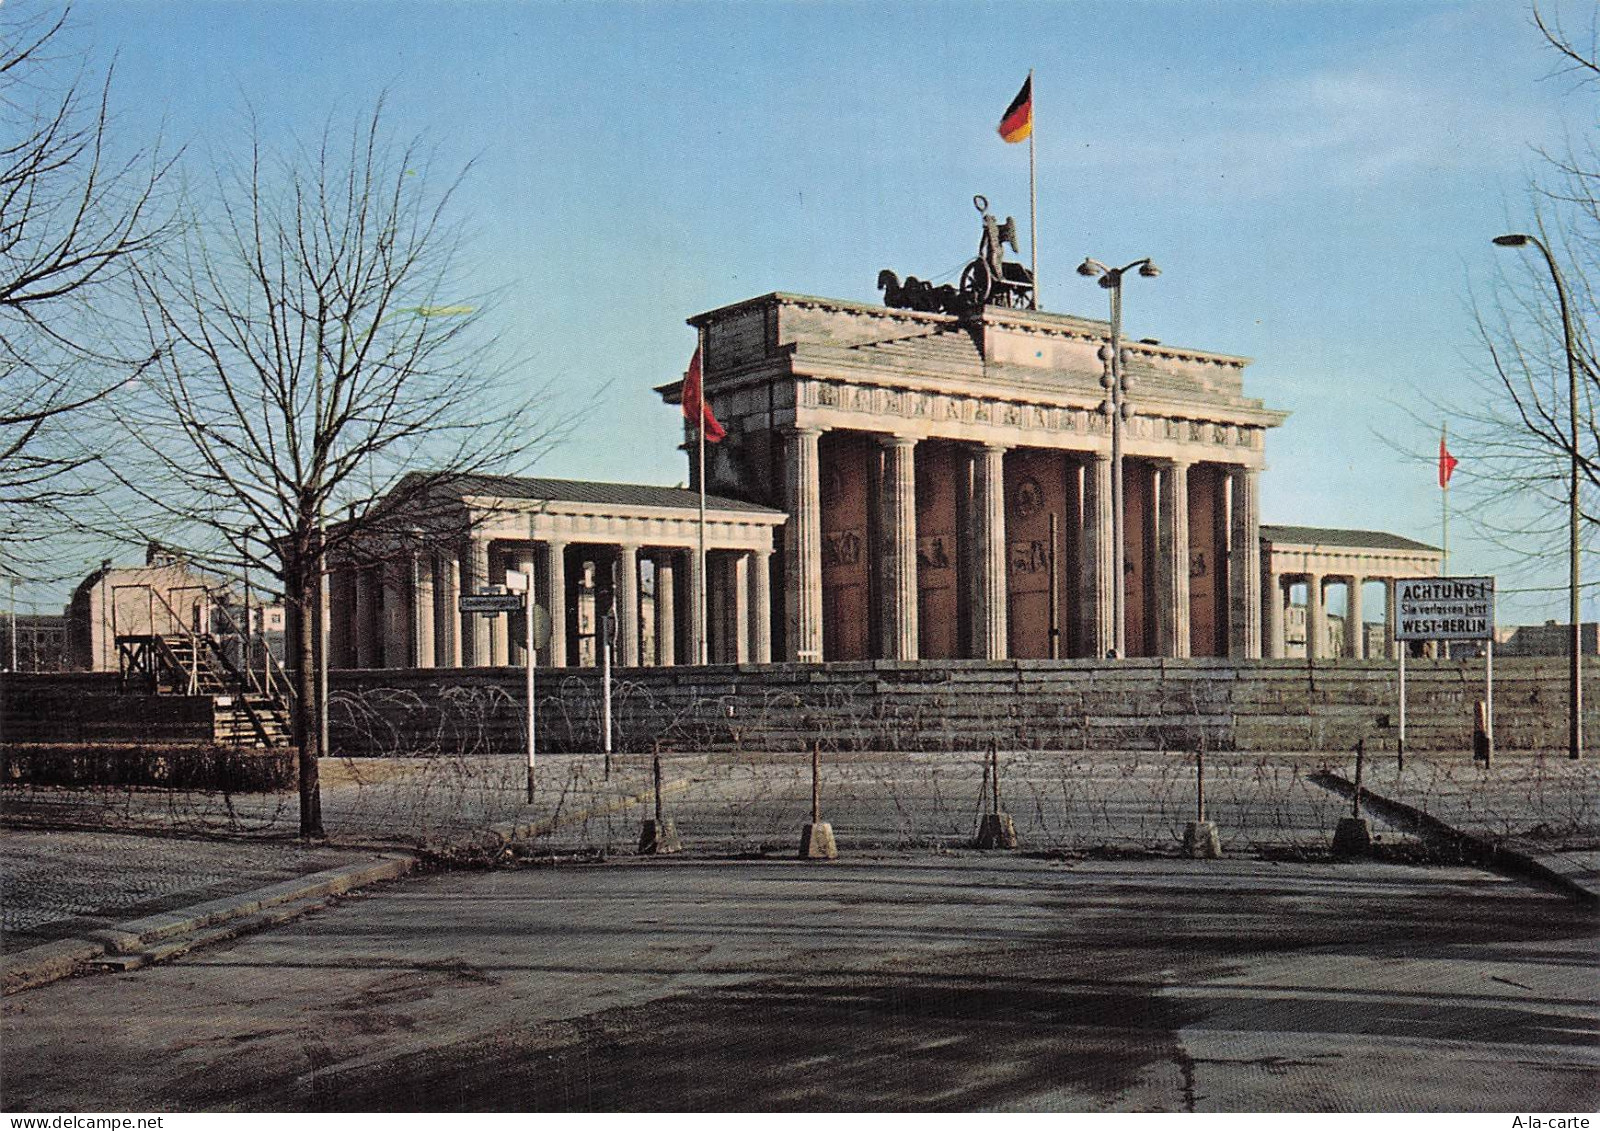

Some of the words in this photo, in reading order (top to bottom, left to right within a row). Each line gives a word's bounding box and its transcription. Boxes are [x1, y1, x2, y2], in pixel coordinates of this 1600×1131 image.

[1419, 603, 1464, 614] verlassen
[1465, 603, 1487, 617] jetzt
[1402, 619, 1486, 633] WEST-BERLIN
